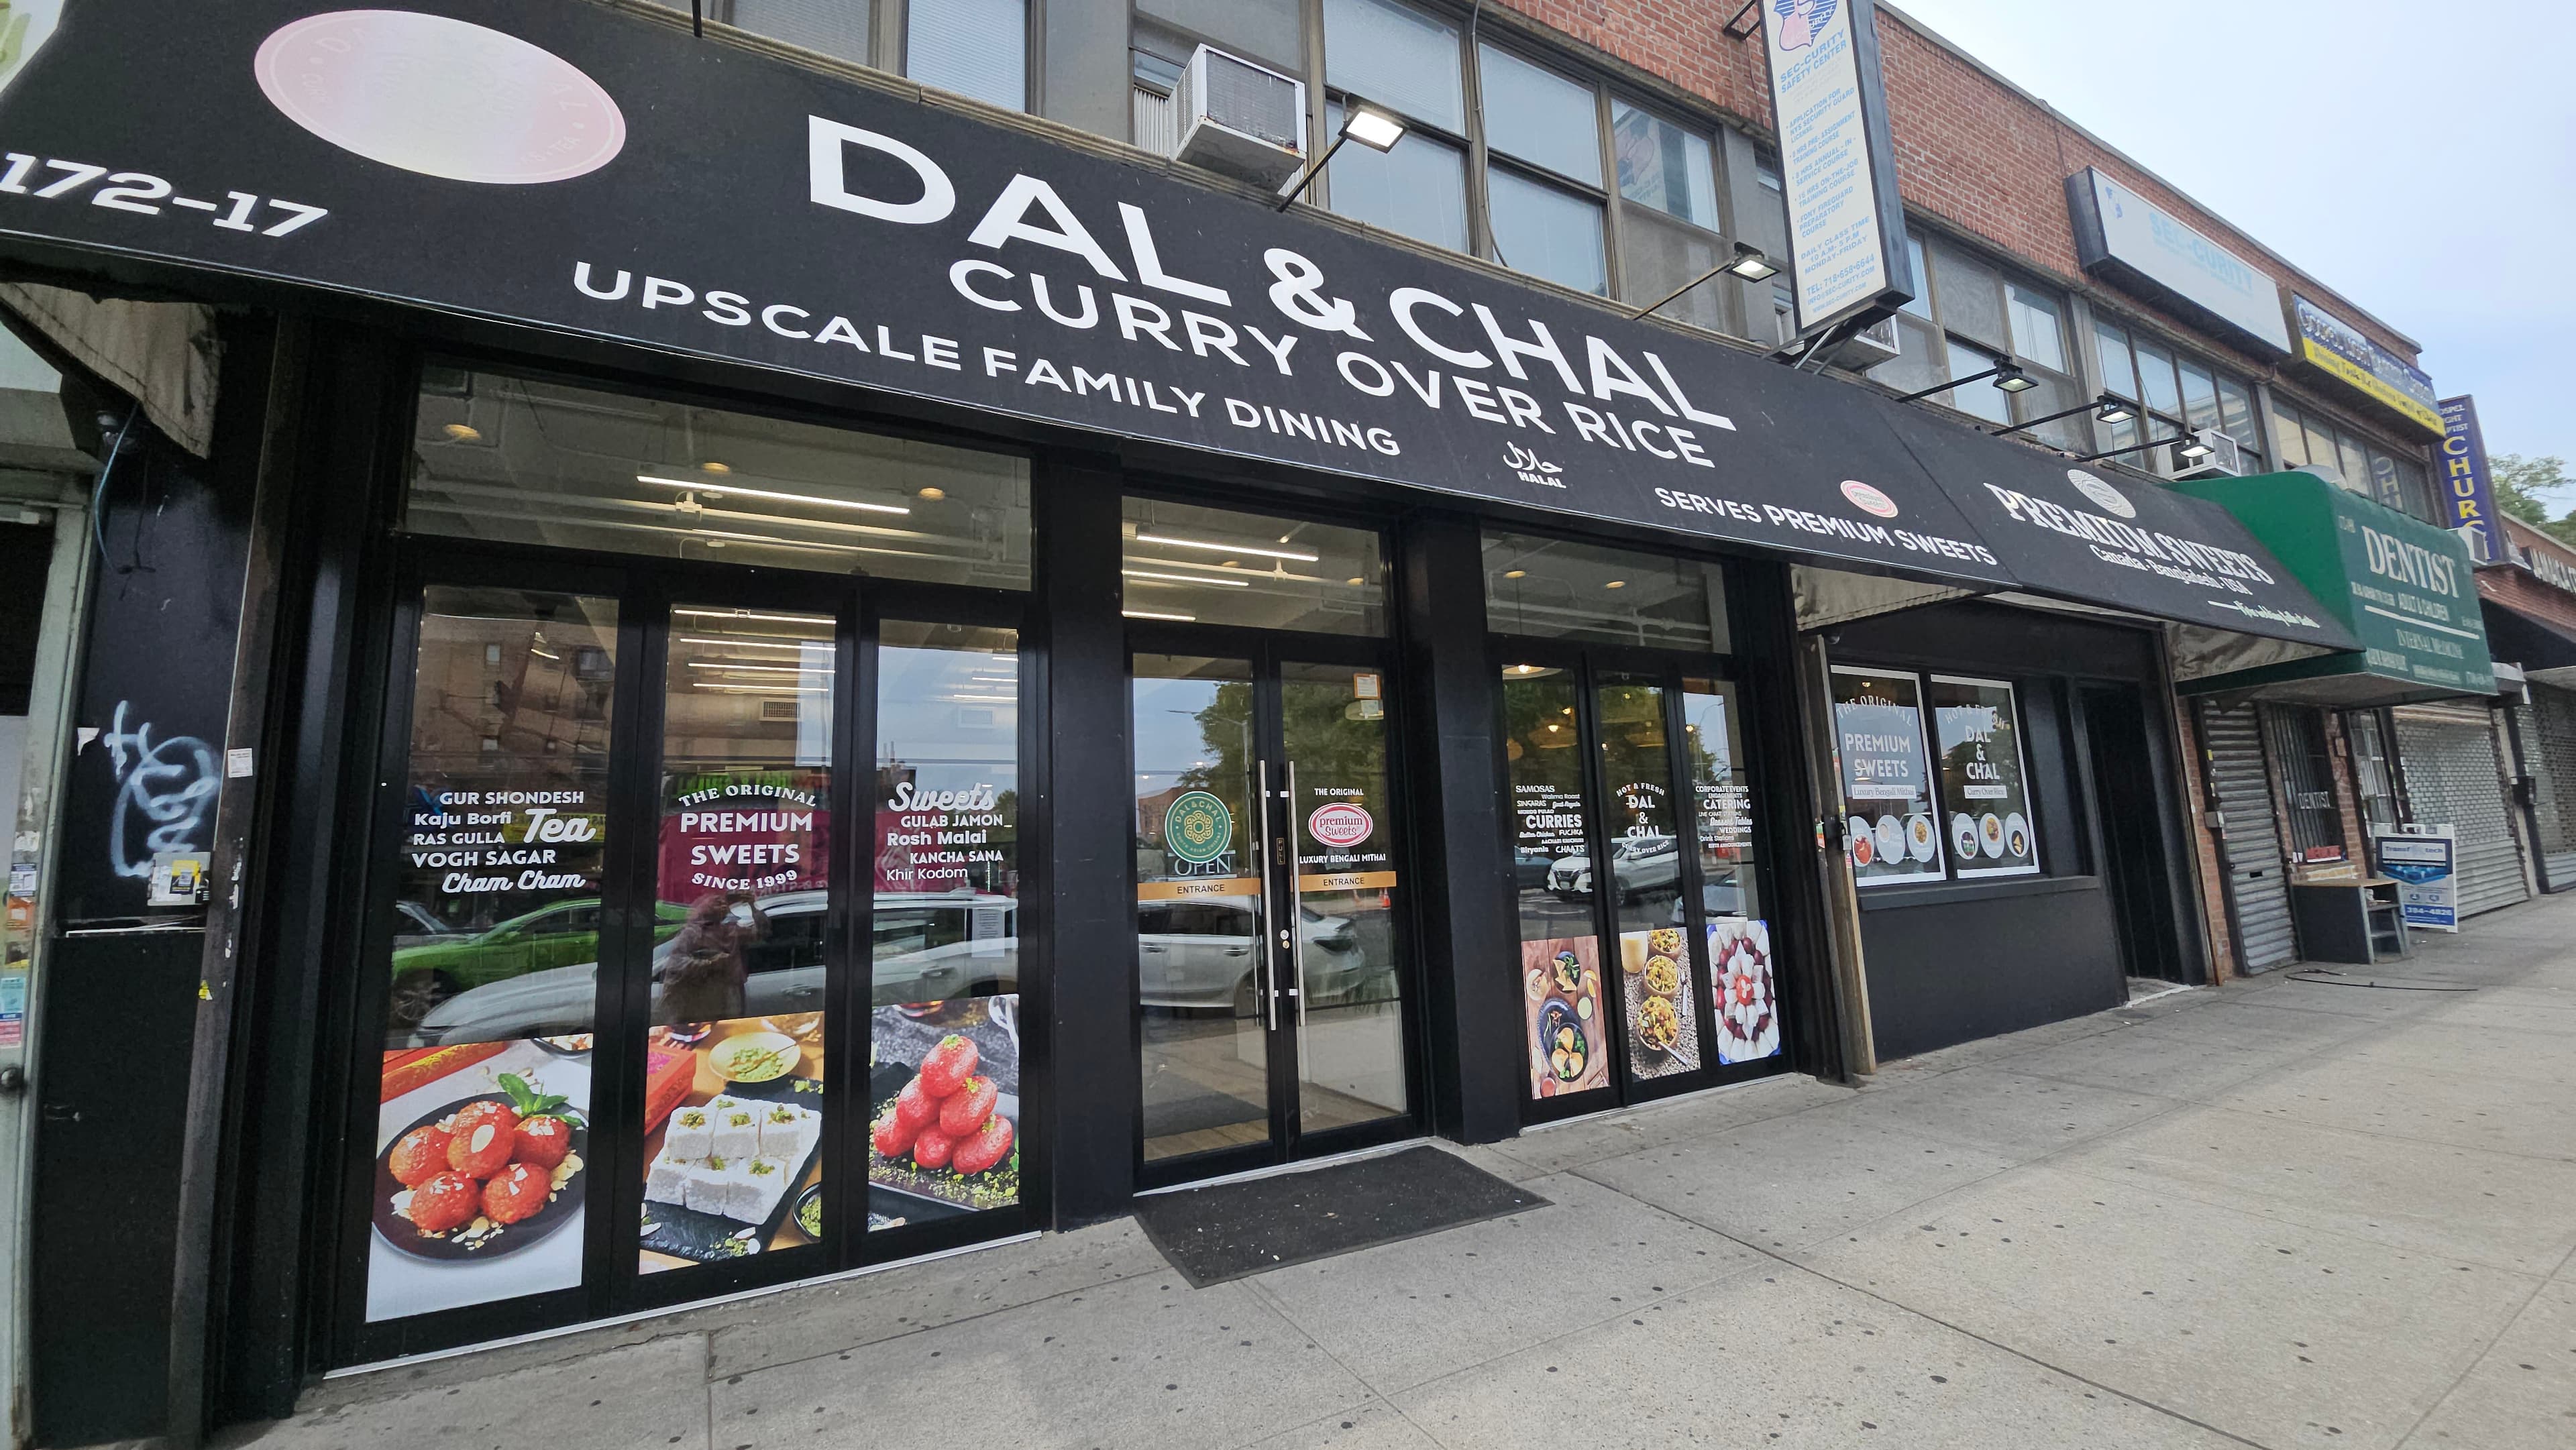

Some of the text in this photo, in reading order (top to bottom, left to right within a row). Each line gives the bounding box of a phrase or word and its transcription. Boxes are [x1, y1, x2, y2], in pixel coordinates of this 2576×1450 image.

[1780, 28, 1844, 82] SEC-CURITY
[1781, 67, 1810, 93] SAFETY
[1813, 40, 1847, 70] CENTER
[1790, 88, 1841, 128] APPLICATION FOR
[1803, 103, 1831, 127] SECURITY
[1833, 87, 1855, 106] GUARD
[1818, 131, 1840, 149] COURSE
[1815, 147, 1839, 167] ANNUAL
[1796, 149, 1848, 187] SERVICE COURSE
[0, 153, 328, 237] 172-17
[1799, 169, 1855, 208] TRAINING COURSE
[1799, 200, 1845, 231] PREPARATORY
[1802, 219, 1827, 238] COURSE
[1801, 216, 1870, 260] DAILY CLASS TIME
[808, 115, 1736, 431] DAL & CHAL
[1807, 282, 1823, 296] TEL:
[574, 262, 1401, 457] UPSCALE FAMILY DINING
[949, 260, 1716, 468] CURRY OVER RICE
[2440, 404, 2465, 414] OSPEL
[1503, 441, 1563, 473] حلال
[1517, 471, 1567, 488] HALAL
[1654, 487, 1997, 566] SERVES PREMIUM SWEETS
[1983, 482, 2275, 585] PREMIUM SWEETS
[2089, 545, 2148, 571] Canada
[2218, 577, 2253, 595] USA
[2361, 526, 2460, 598] DENTIST
[1836, 695, 1911, 726] THE ORIGINAL
[1845, 733, 1911, 752] PREMIUM
[1966, 725, 1991, 742] DAL
[1976, 744, 1986, 761] &
[1854, 759, 1909, 777] SWEETS
[1966, 762, 2000, 779] CHAL
[439, 791, 584, 805] GUR SHONDESH
[678, 784, 816, 807] THE ORIGINAL
[887, 782, 995, 812] Sweets
[1314, 788, 1364, 796] THE ORIGINAL
[1616, 785, 1631, 797] HOT
[1641, 783, 1665, 795] FRESH
[1854, 787, 1874, 797] Luxury
[1628, 795, 1655, 808] DAL
[1703, 799, 1751, 810] CATERING
[2298, 791, 2330, 809] DENTIST
[415, 811, 512, 829] Kaju Borfi
[900, 814, 1003, 828] GULAB JAMON
[1175, 804, 1190, 823] DAL
[1199, 801, 1222, 822] CHAL
[1525, 814, 1582, 828] CURRIES
[1639, 812, 1648, 824] &
[523, 808, 596, 843] Tea
[680, 812, 813, 833] PREMIUM
[1319, 815, 1363, 828] premium
[1325, 825, 1357, 836] Sweets
[413, 832, 505, 845] RAS GULLA
[887, 830, 987, 846] Rosh Malai
[1627, 826, 1662, 838] CHAL
[690, 844, 800, 866] SWEETS
[1520, 846, 1549, 854] Biryanis
[1556, 845, 1585, 853] CHAATS
[1621, 842, 1642, 853] CURRY
[1658, 840, 1670, 850] RICE
[411, 850, 556, 868] VOGH SAGAR
[910, 849, 1004, 865] KANCHA SANA
[1174, 856, 1231, 875] OPEN
[1299, 852, 1387, 864] LUXURY BENGALI MITHAI
[441, 870, 586, 893] Cham Cham
[692, 873, 750, 890] SINCE
[757, 870, 798, 889] 1999
[886, 867, 968, 881] Khir Kodom
[1323, 877, 1365, 886] ENTRANCE
[1177, 884, 1226, 895] ENTRANCE
